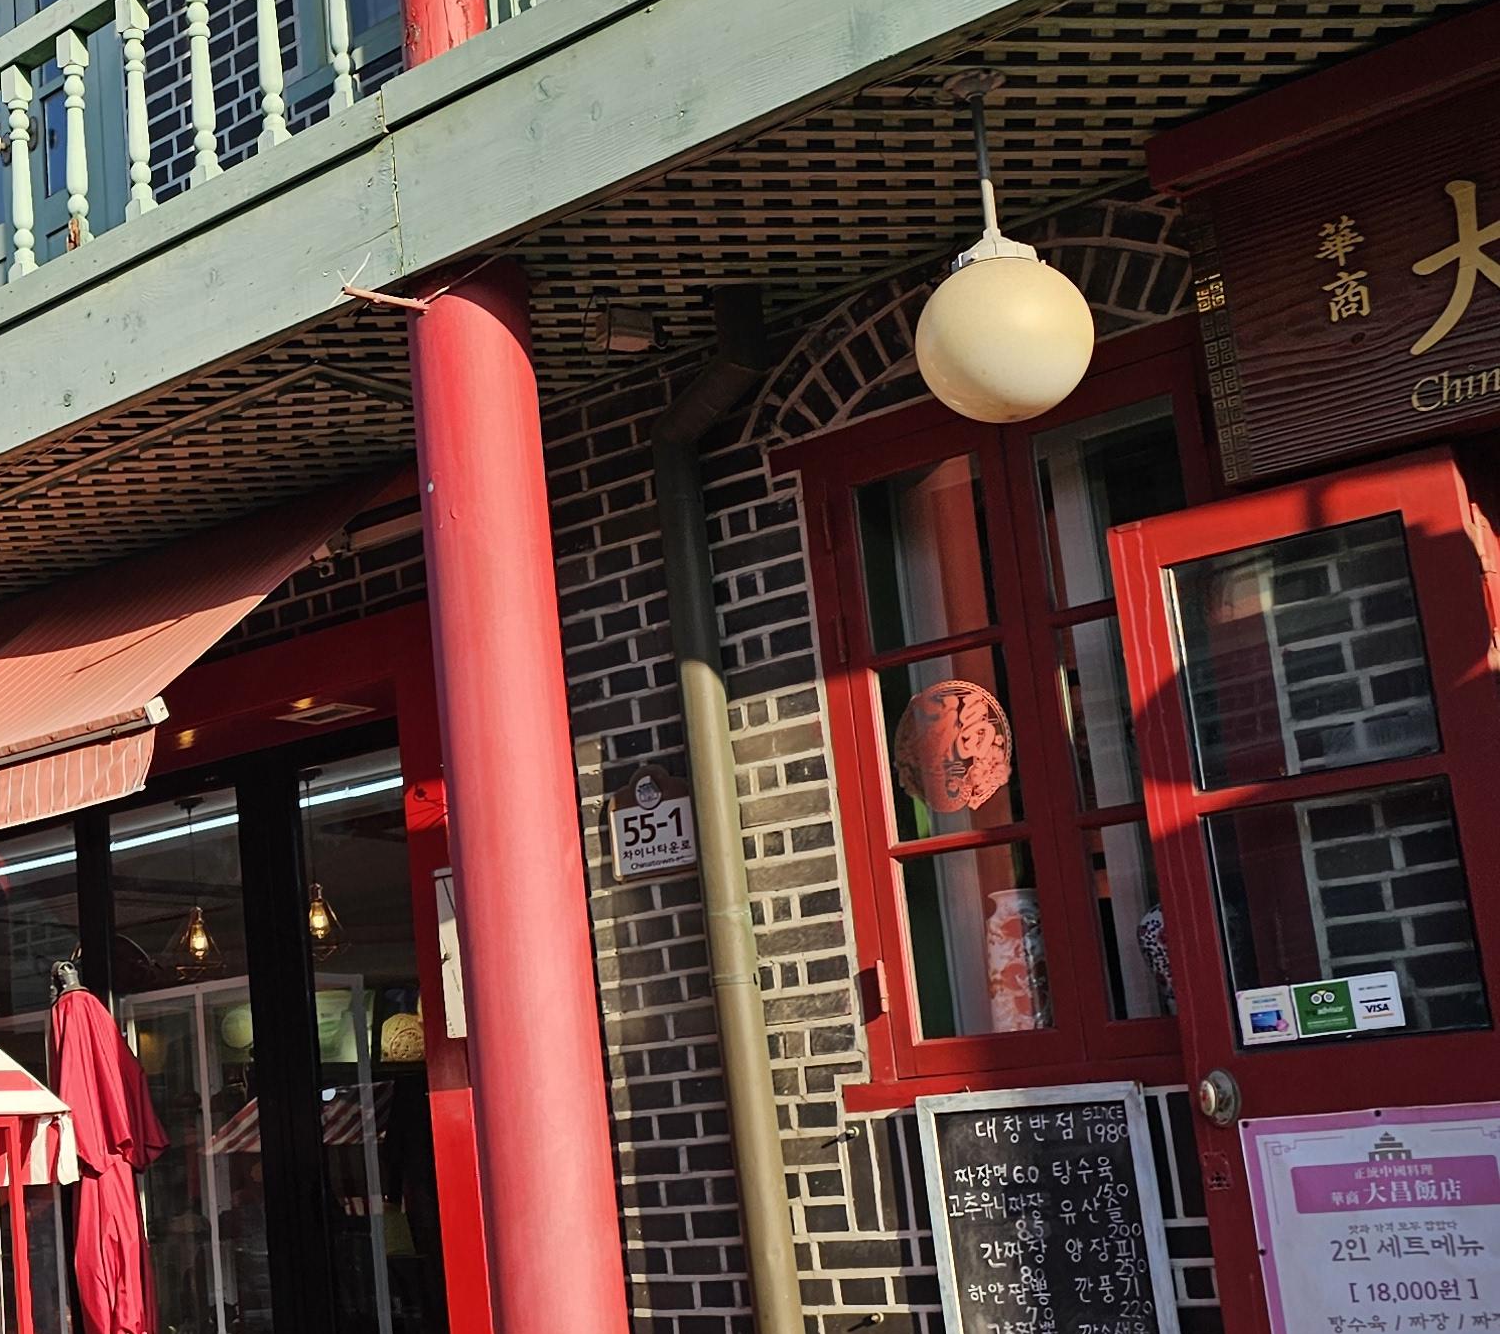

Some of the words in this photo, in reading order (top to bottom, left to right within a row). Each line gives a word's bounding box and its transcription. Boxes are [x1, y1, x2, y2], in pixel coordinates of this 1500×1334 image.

[1313, 214, 1371, 323] 華商
[623, 806, 683, 847] 55-1
[623, 839, 692, 860] 차이나타운로
[1364, 1003, 1390, 1013] VISA
[975, 1111, 1074, 1144] 대창반점
[1086, 1123, 1129, 1144] 1980
[954, 1163, 1009, 1188] 짜장면
[1012, 1165, 1040, 1184] 6.0
[1052, 1156, 1113, 1185] 탕수육
[1363, 1178, 1463, 1205] 大昌飯店
[1330, 1236, 1372, 1262] 2인
[1377, 1233, 1485, 1260] 세트메뉴
[1366, 1278, 1462, 1304] 18,000원
[1327, 1314, 1387, 1334] 탕수육
[1409, 1312, 1450, 1330] 짜장
